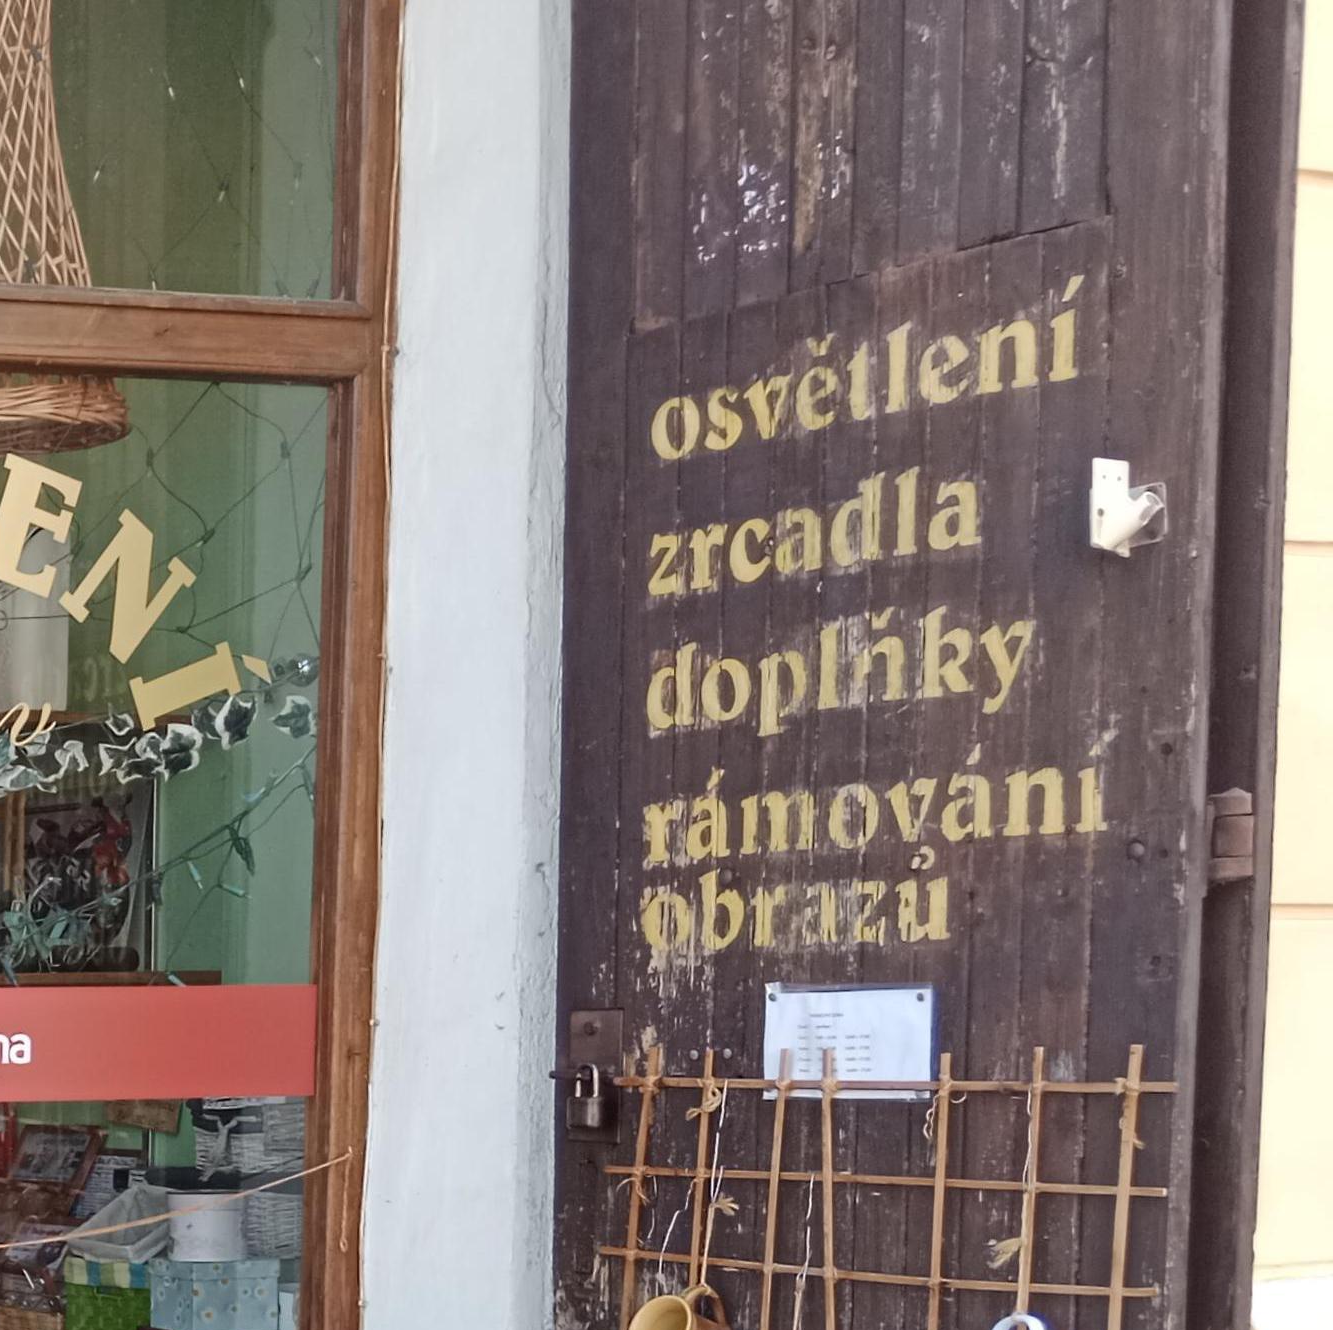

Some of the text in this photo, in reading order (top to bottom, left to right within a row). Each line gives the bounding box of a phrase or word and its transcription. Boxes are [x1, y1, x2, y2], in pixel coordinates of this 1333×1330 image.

[650, 275, 1085, 461] osvětlení
[647, 466, 983, 597] zrcadla
[646, 605, 1034, 738] doplňky
[641, 728, 1115, 864] rámování
[639, 848, 952, 954] obrazů
